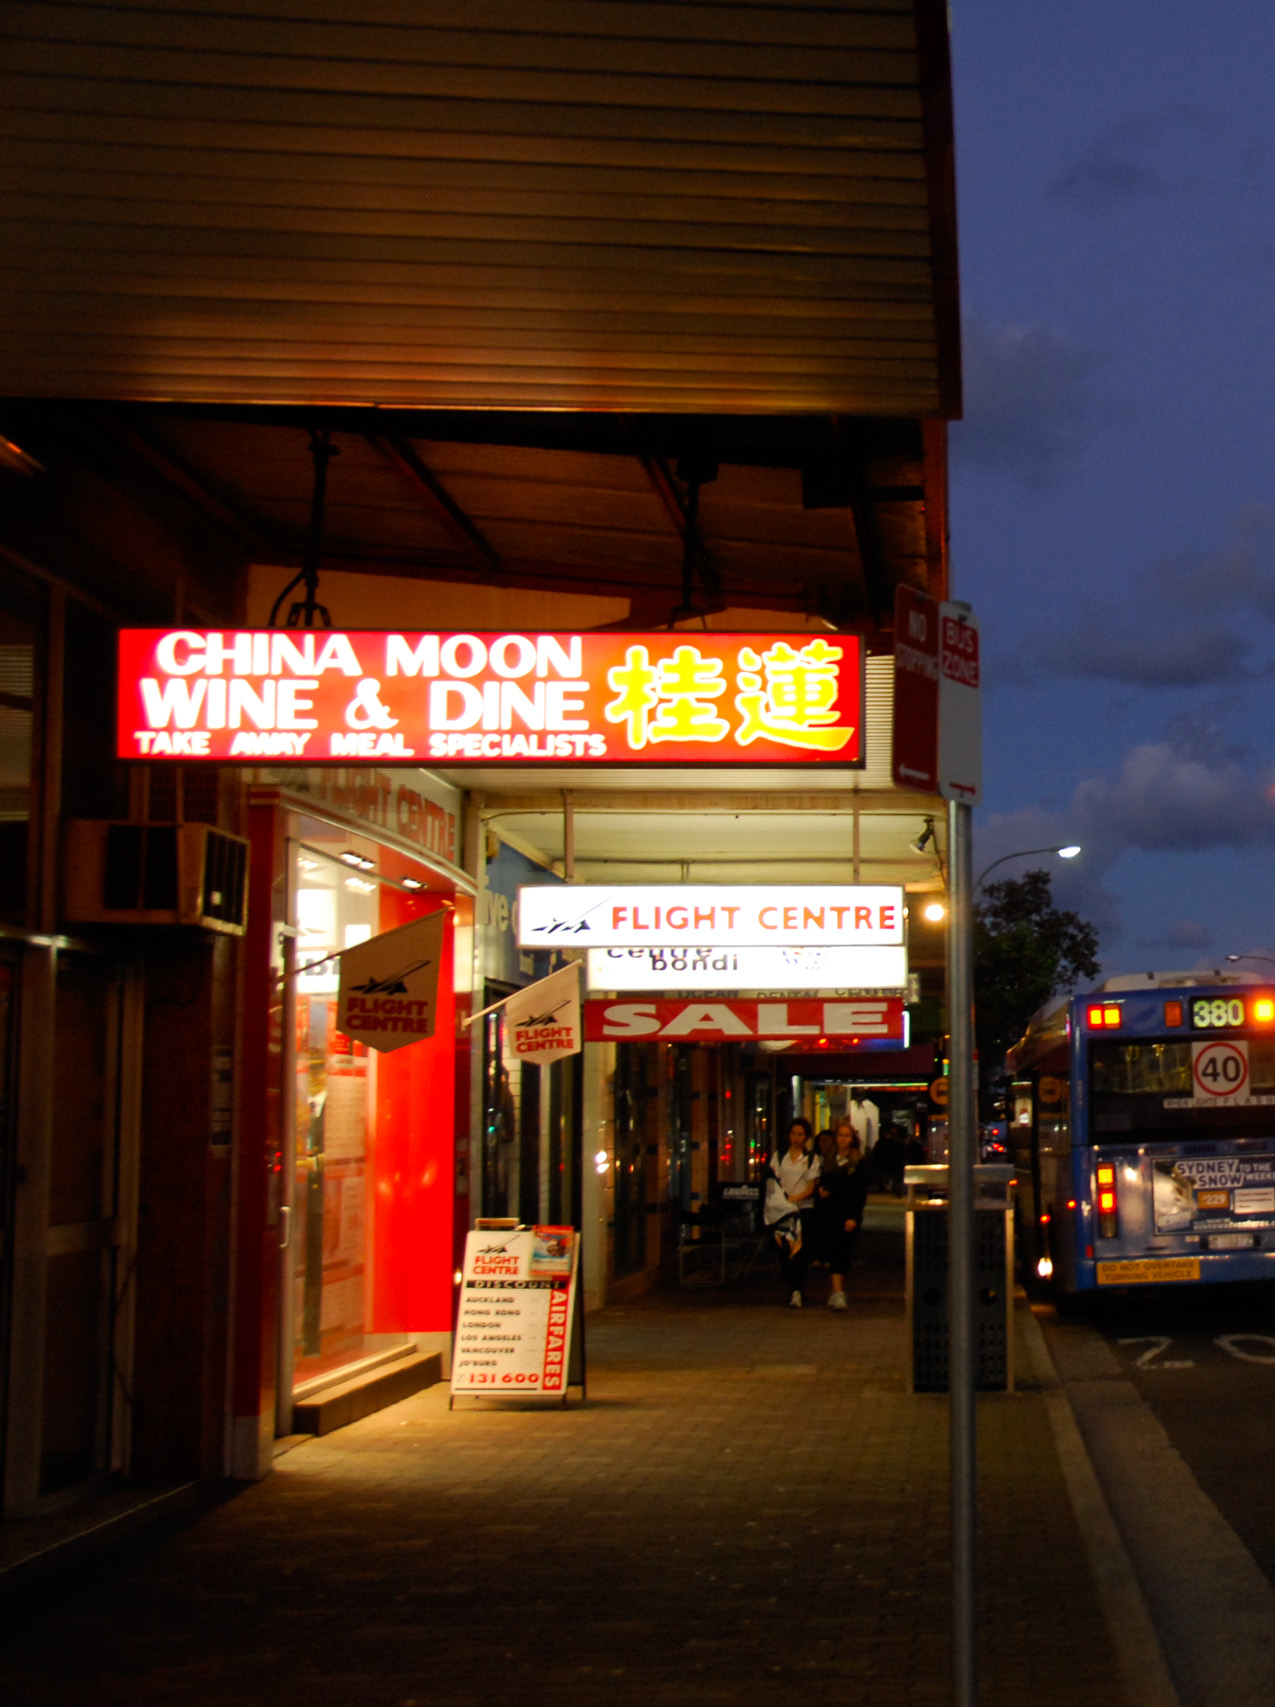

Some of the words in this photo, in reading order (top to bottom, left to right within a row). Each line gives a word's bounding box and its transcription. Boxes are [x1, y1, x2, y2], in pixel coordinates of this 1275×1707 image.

[908, 610, 928, 643] NO
[946, 622, 975, 653] BUS
[155, 632, 363, 678] CHINA
[385, 634, 584, 679] MOON
[943, 651, 978, 686] ZONE
[141, 678, 318, 731] WINE
[345, 680, 399, 731] &
[428, 680, 590, 731] DINE
[134, 730, 212, 755] TAKE
[230, 731, 311, 756] AWAY
[330, 732, 413, 757] MEAL
[429, 732, 607, 757] SPECIALISTS
[397, 784, 455, 861] CENTRE
[611, 905, 741, 931] FLIGHT
[757, 905, 896, 931] CENTRE
[651, 955, 738, 971] bondi
[346, 996, 429, 1018] FLIGHT
[1193, 998, 1245, 1028] 380
[345, 1013, 429, 1036] CENTRE
[602, 1002, 889, 1037] SALE
[515, 1025, 574, 1042] FLIGHT
[516, 1037, 575, 1054] CENTRE
[1201, 1056, 1240, 1083] 40
[1176, 1161, 1237, 1175] SYDNEY
[1253, 1163, 1271, 1172] THE
[1198, 1174, 1243, 1187] SNOW
[472, 1266, 520, 1275] CENTRE
[474, 1256, 520, 1266] FLIGHT
[1101, 1264, 1116, 1272] DO
[1119, 1263, 1140, 1271] NOT
[1144, 1260, 1195, 1270] OVERTAKE
[474, 1281, 561, 1289] DISCOUNT
[465, 1296, 515, 1304] AUCKLAND
[543, 1290, 568, 1388] AIRFARES
[469, 1373, 496, 1384] 131
[501, 1373, 540, 1384] 600
